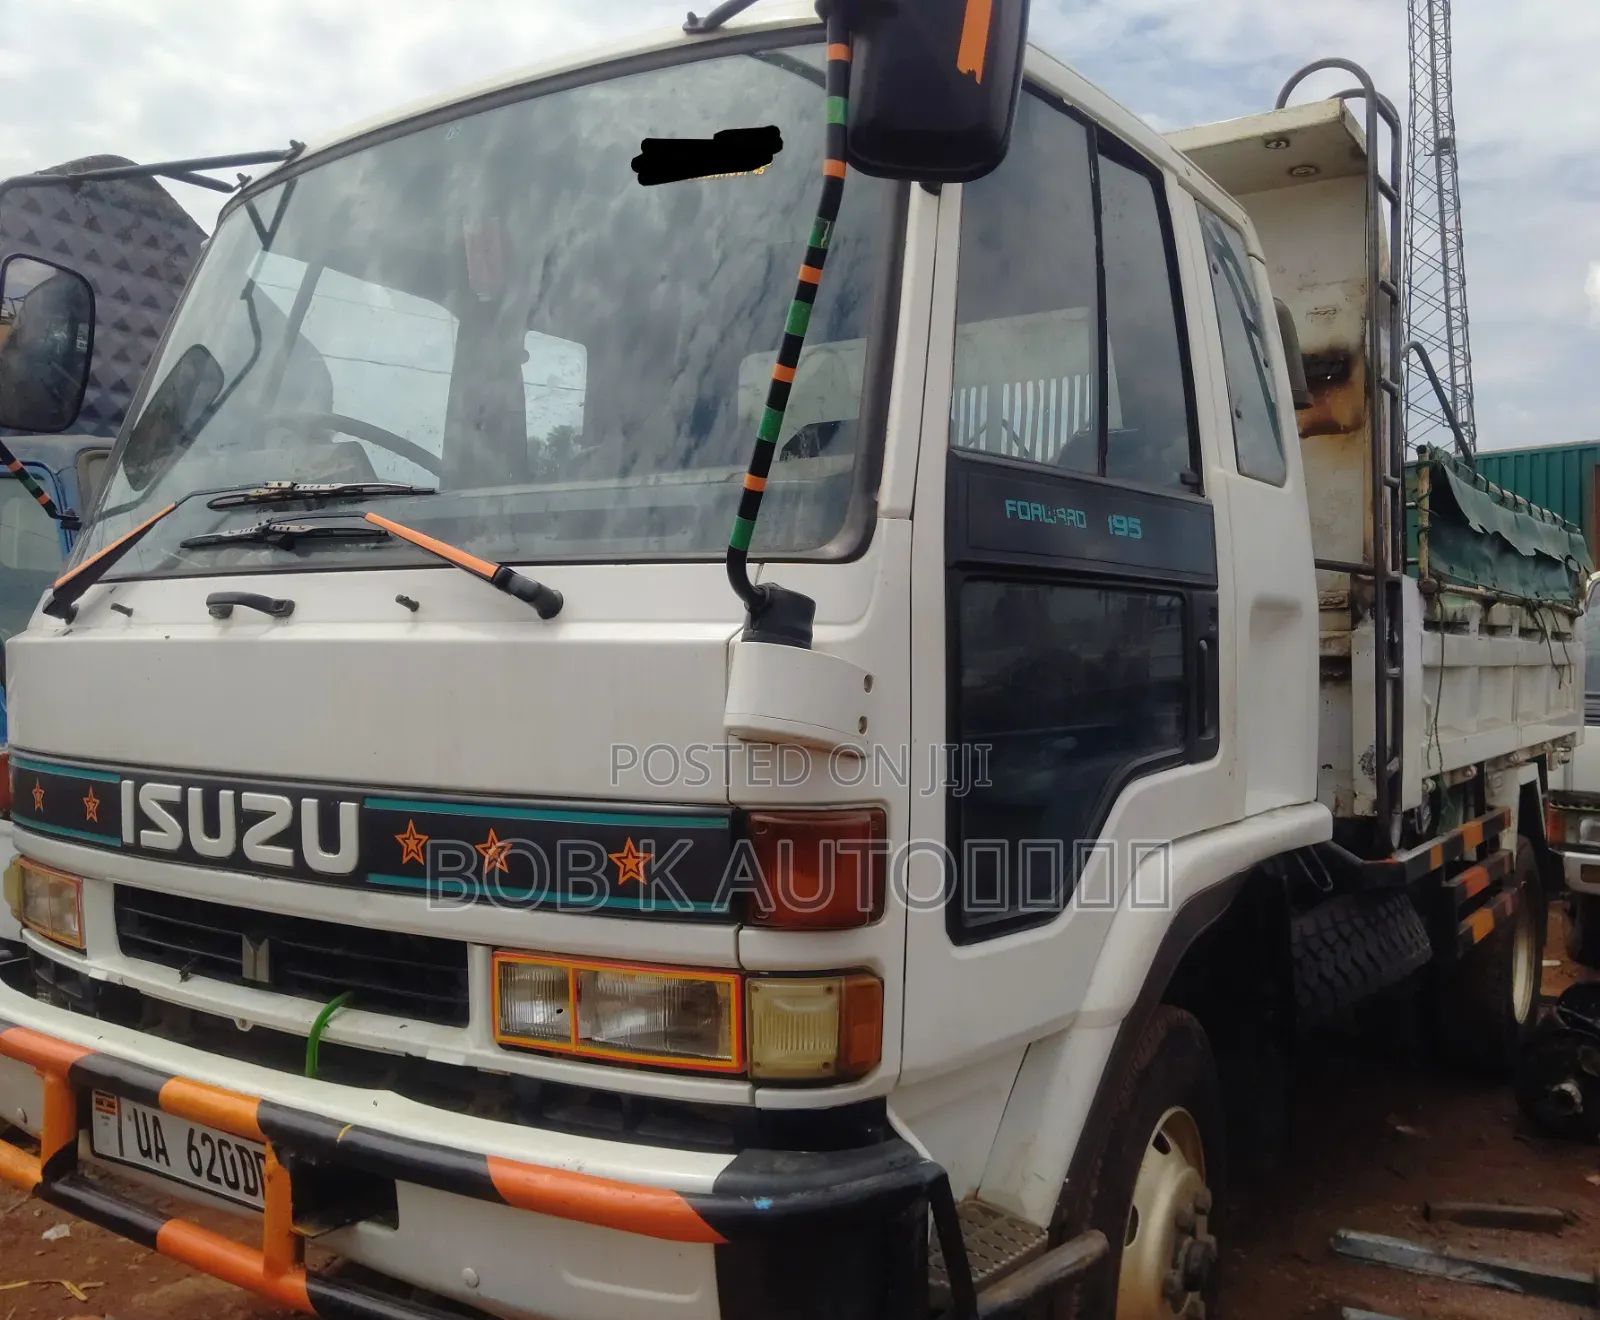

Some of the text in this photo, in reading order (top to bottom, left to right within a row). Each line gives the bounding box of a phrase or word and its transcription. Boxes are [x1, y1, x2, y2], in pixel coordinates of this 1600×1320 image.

[1107, 514, 1142, 539] 195
[120, 779, 360, 875] ISUZU
[133, 1107, 171, 1168] UA
